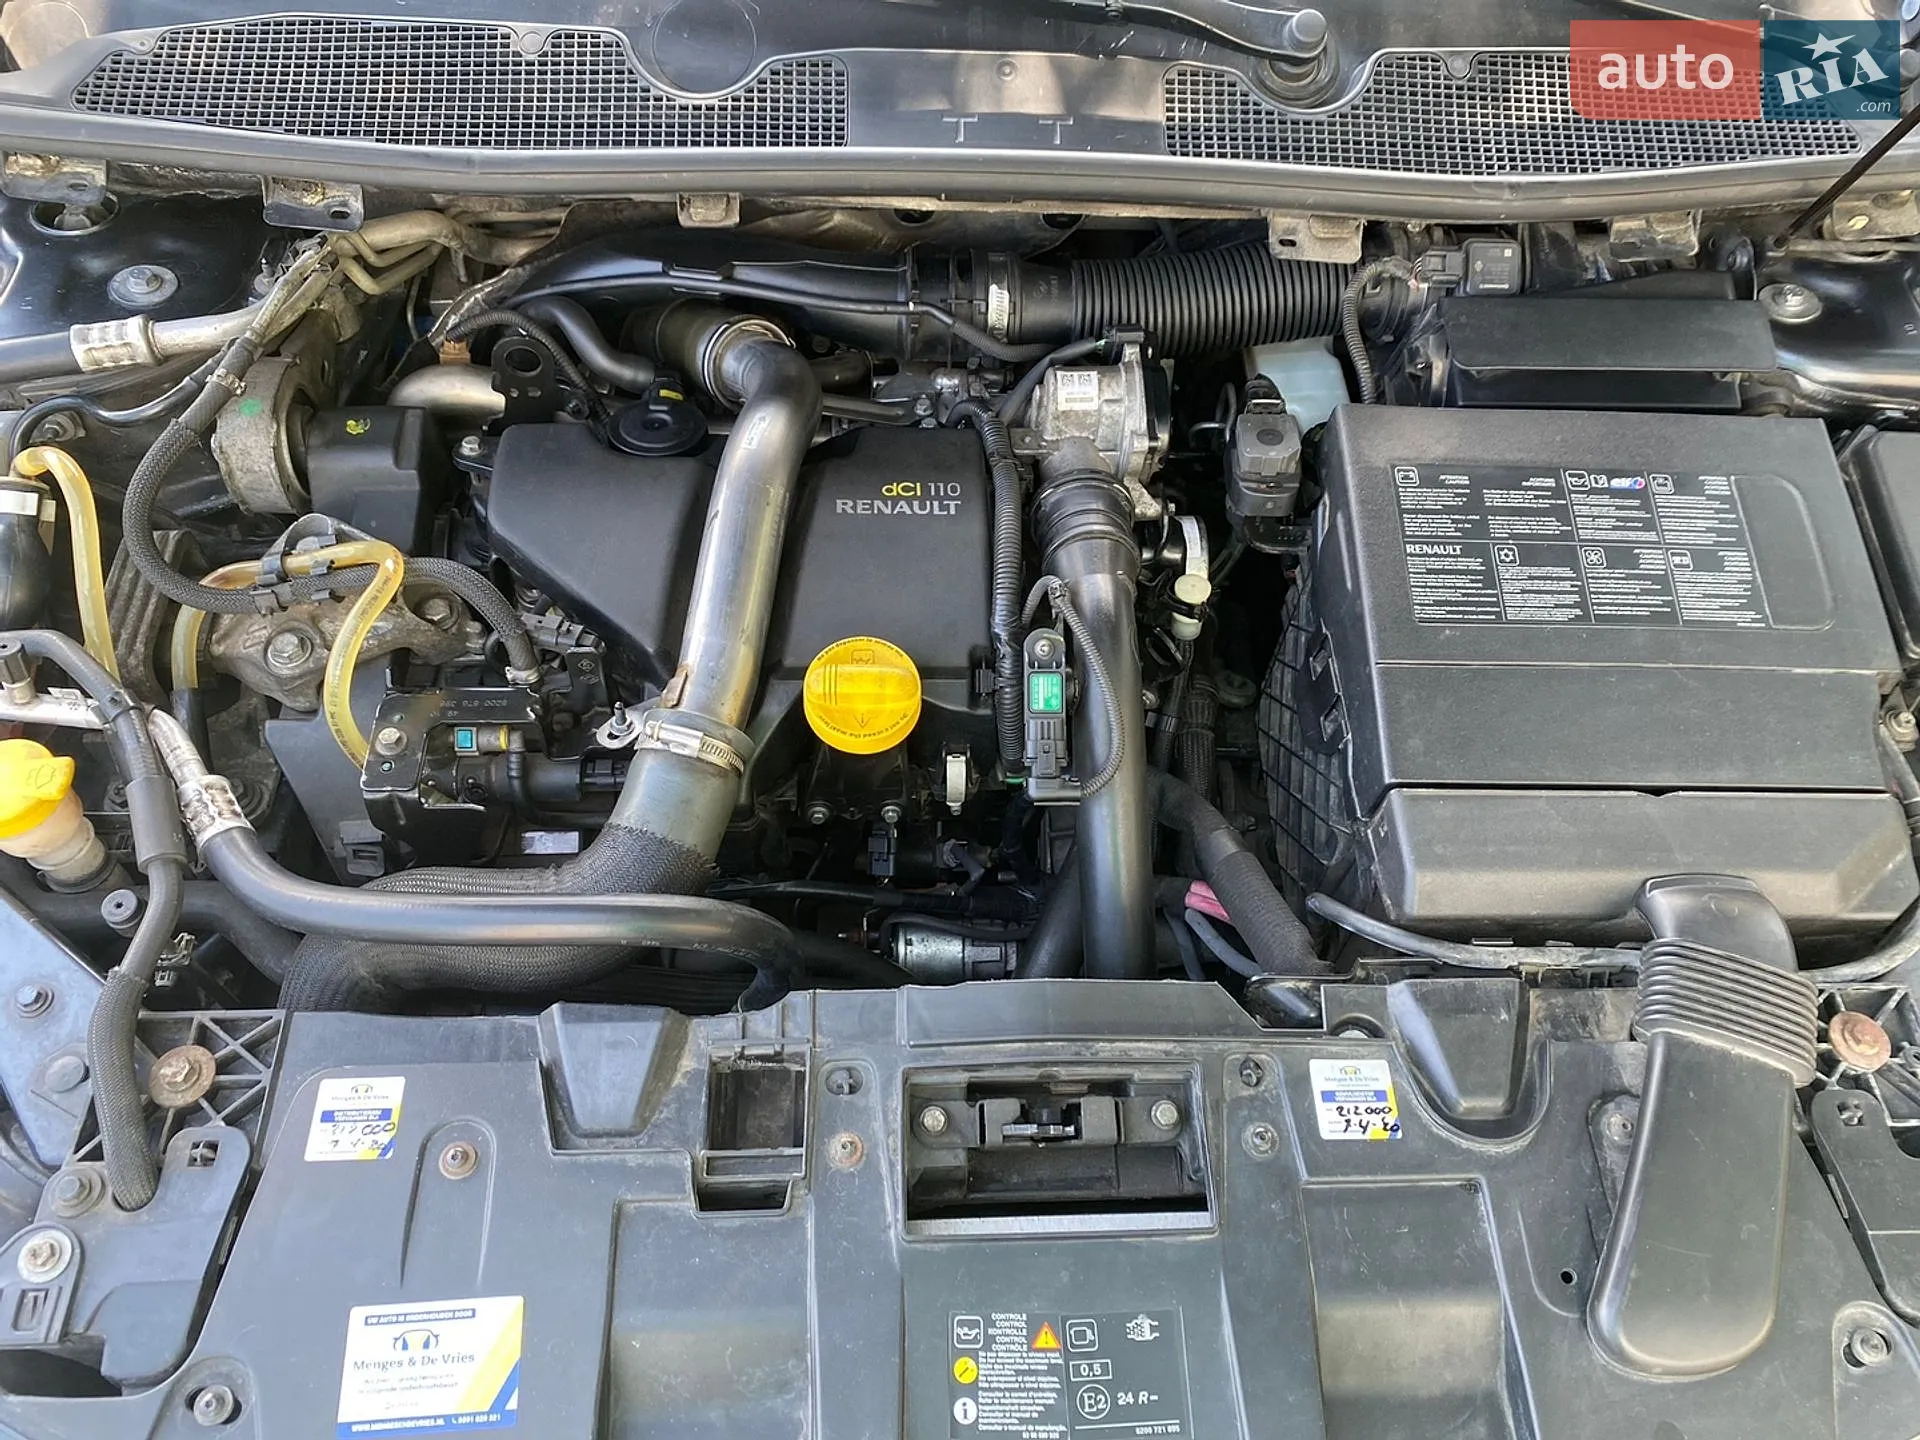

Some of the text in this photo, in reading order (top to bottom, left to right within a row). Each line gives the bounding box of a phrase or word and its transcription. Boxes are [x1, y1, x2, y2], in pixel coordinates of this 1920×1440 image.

[928, 482, 961, 497] 110
[836, 499, 962, 515] RENAULT
[1405, 543, 1463, 555] RENAULT
[352, 1352, 475, 1373] Menges & De Vries
[1080, 1363, 1101, 1377] 0,5
[1083, 1392, 1106, 1412] E2
[1117, 1391, 1134, 1405] 24
